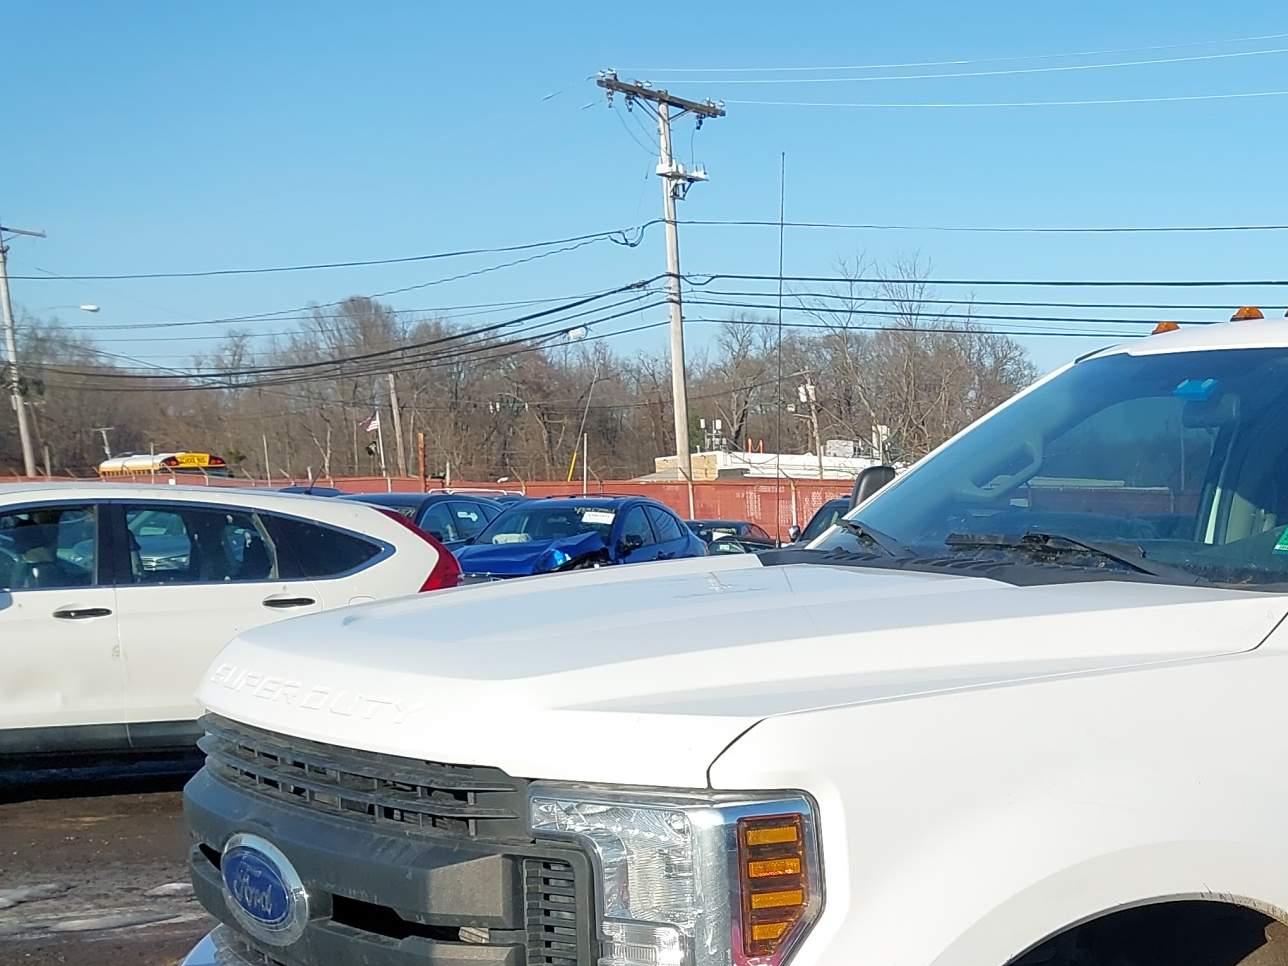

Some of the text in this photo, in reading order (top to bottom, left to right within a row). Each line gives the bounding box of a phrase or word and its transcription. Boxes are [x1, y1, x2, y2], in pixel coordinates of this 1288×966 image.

[211, 664, 425, 725] SUPER DUTY
[233, 860, 274, 916] Ford
